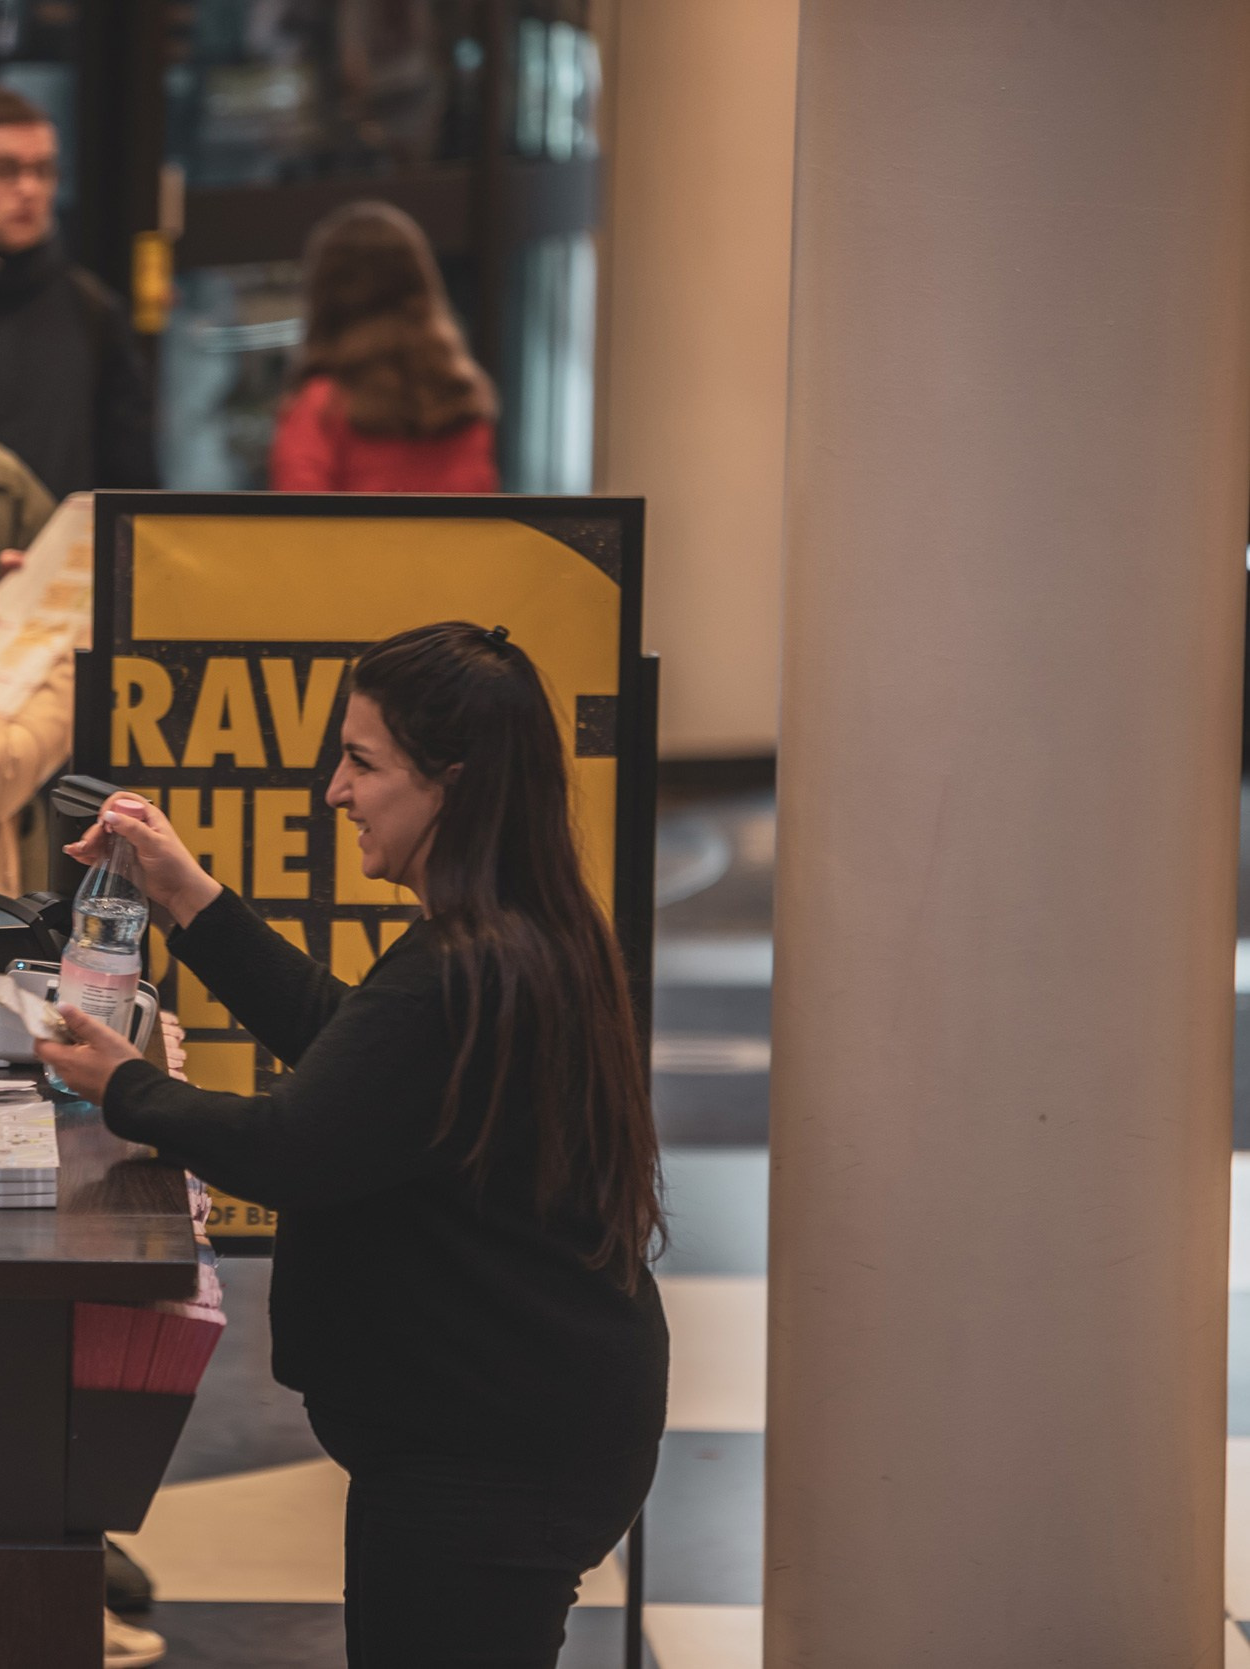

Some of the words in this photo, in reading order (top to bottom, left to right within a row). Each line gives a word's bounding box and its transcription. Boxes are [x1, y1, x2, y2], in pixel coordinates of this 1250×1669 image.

[111, 655, 356, 769] RAV
[124, 787, 312, 900] HE
[207, 1206, 236, 1226] OF
